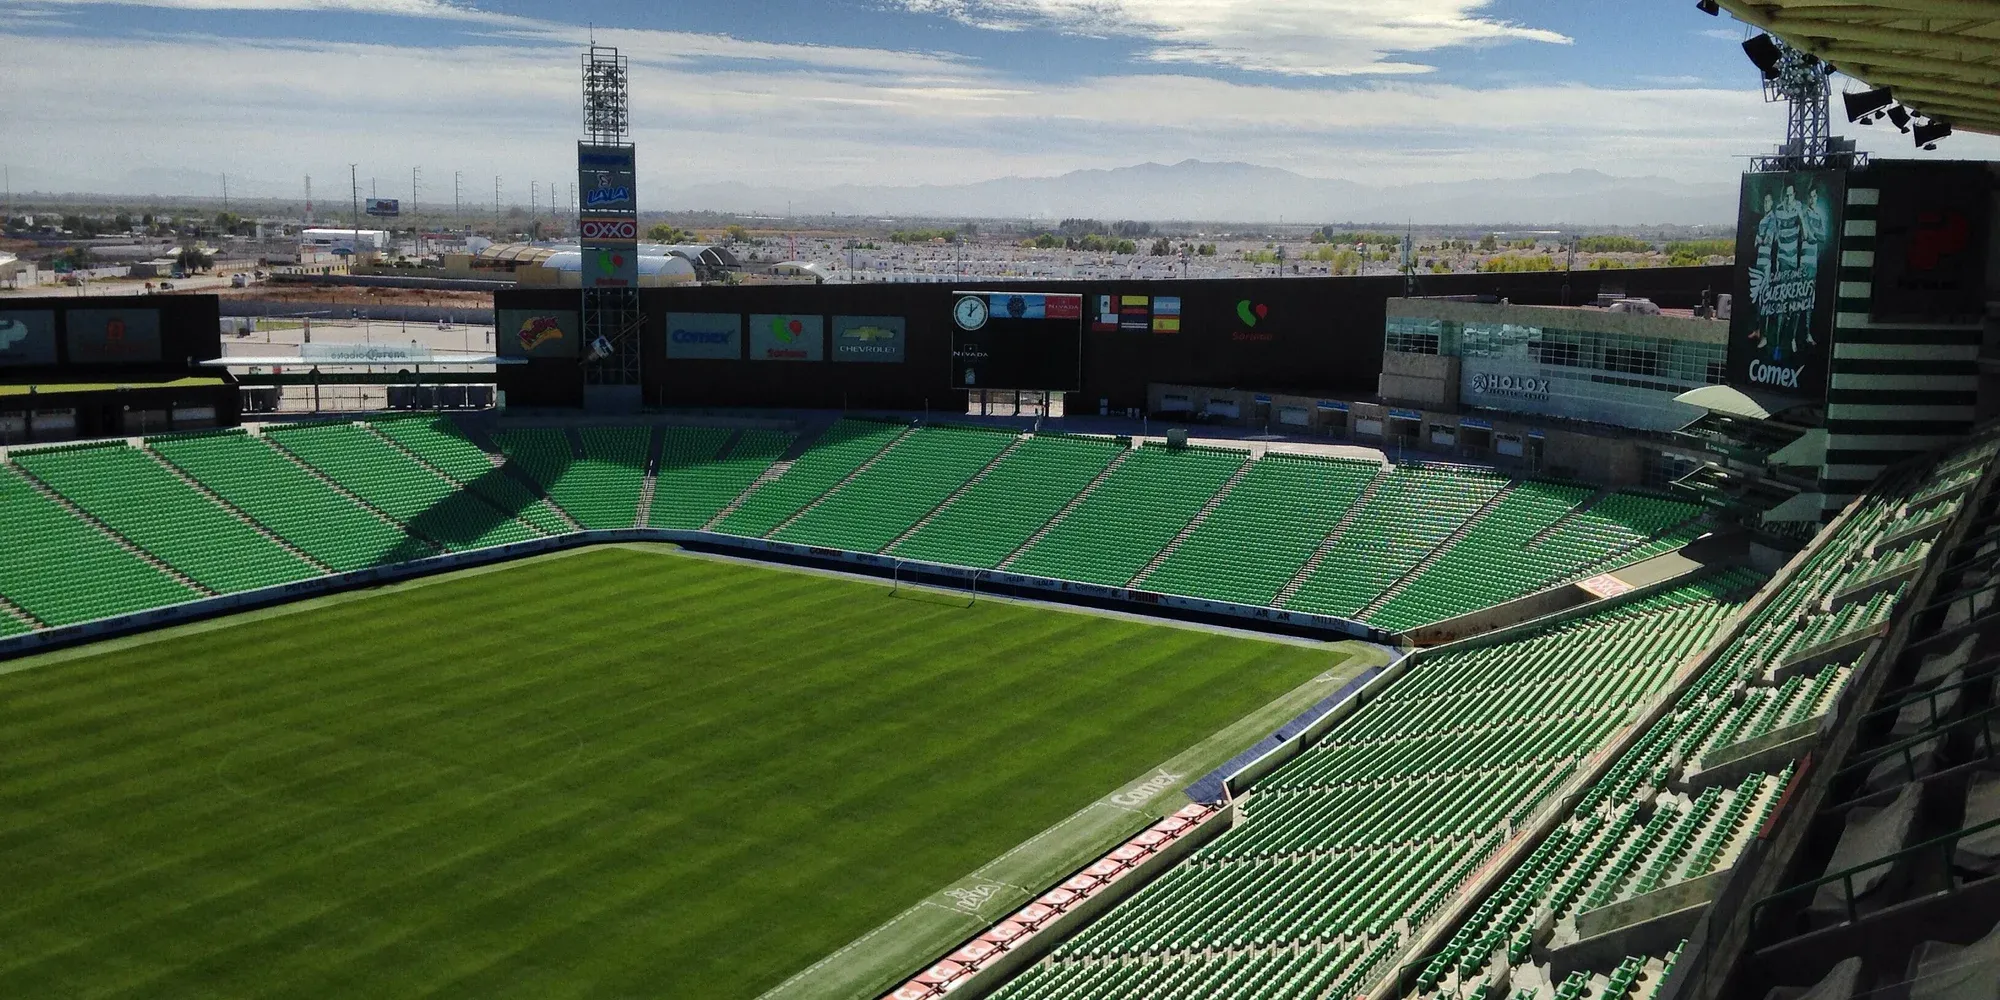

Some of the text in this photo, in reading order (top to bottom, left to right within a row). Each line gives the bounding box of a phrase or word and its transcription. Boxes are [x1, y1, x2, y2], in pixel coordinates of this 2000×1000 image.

[587, 186, 629, 204] LALA
[583, 222, 635, 238] OXXO
[672, 329, 735, 344] Comex
[839, 345, 897, 353] CHEVROLET
[1749, 359, 1806, 388] Comex
[1488, 374, 1550, 393] HOLOX
[1110, 768, 1184, 806] Comex
